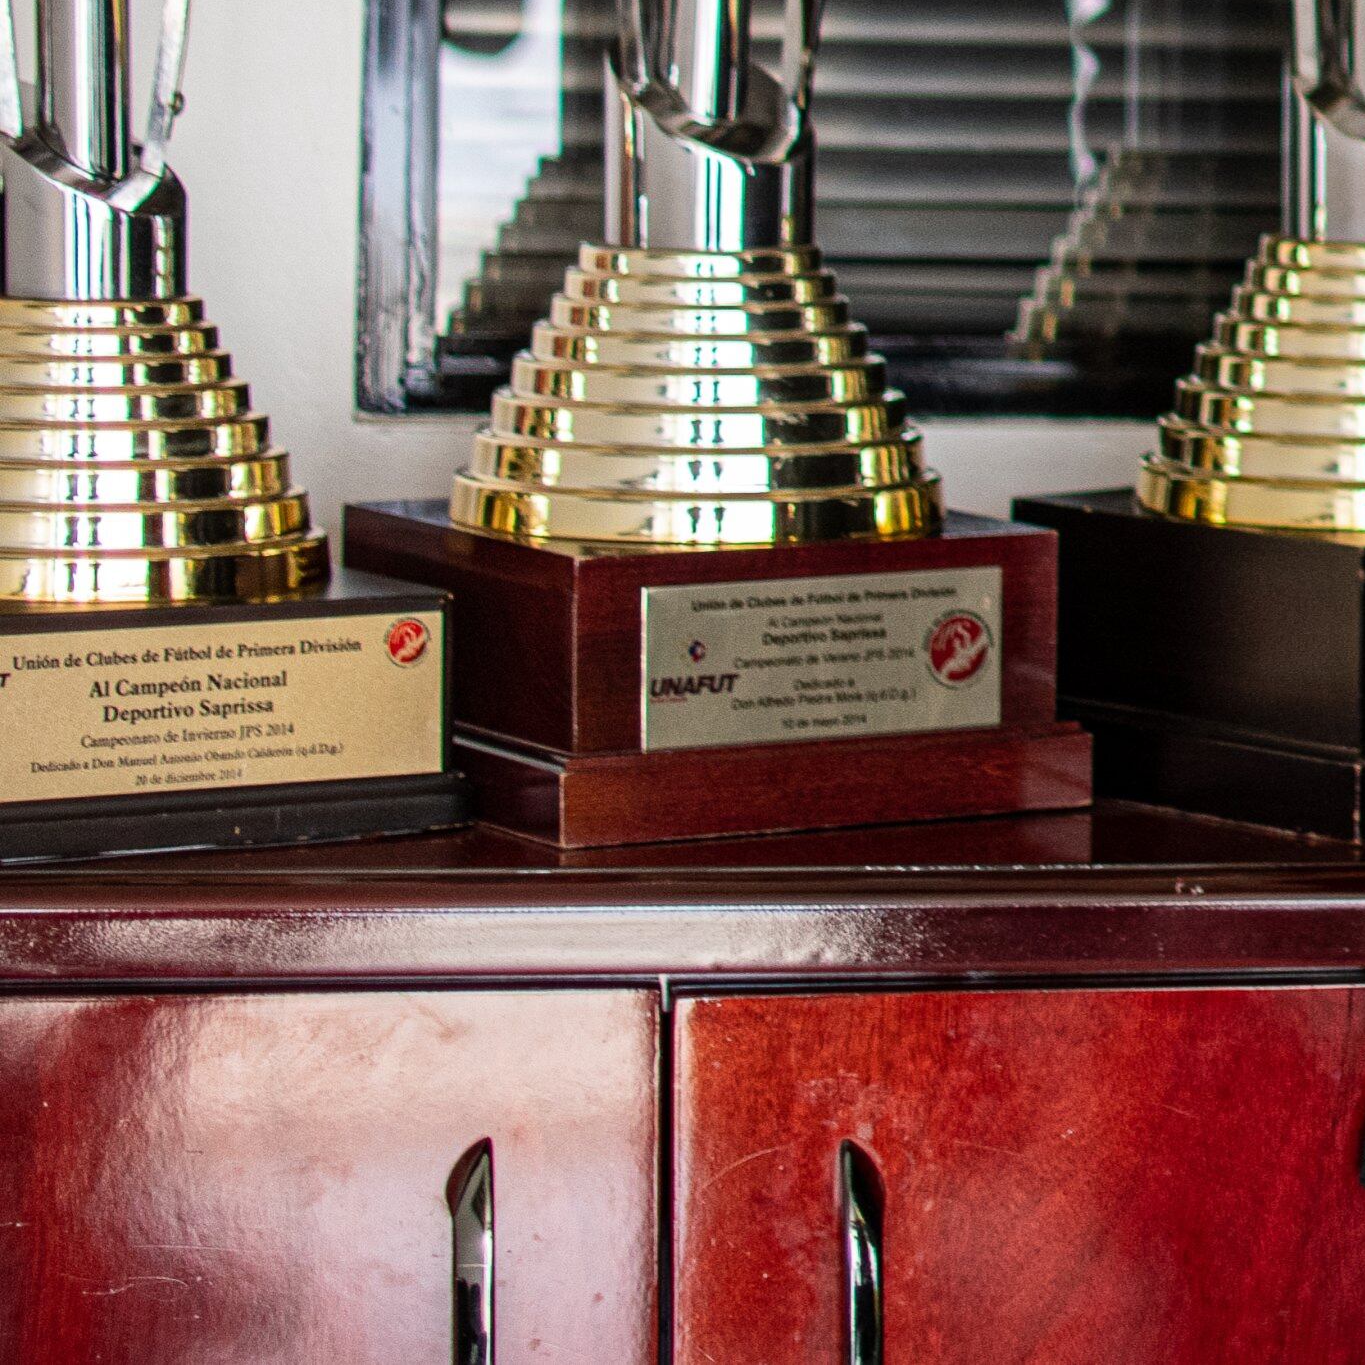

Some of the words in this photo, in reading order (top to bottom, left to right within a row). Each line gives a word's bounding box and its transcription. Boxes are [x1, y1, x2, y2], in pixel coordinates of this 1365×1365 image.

[762, 632, 827, 646] Deportivo
[13, 654, 60, 670] Unión
[64, 653, 82, 668] de
[86, 651, 138, 667] Clubes
[142, 649, 160, 664] de
[163, 646, 211, 662] Fútbol
[216, 645, 233, 660] de
[237, 642, 296, 658] Primera
[299, 637, 363, 655] División
[89, 680, 110, 698] Al
[115, 674, 202, 697] Campeón
[207, 670, 287, 692] Nacional
[650, 674, 738, 697] UNAFUT
[103, 701, 194, 724] Deportivo
[200, 697, 274, 719] Saprissa
[80, 733, 161, 749] Campeonato
[163, 730, 179, 743] de
[182, 728, 236, 743] Invierno
[239, 724, 262, 740] JPS
[266, 722, 295, 737] 2014
[30, 759, 81, 773] Dedicado
[92, 758, 115, 769] Don
[117, 754, 157, 767] Manuel
